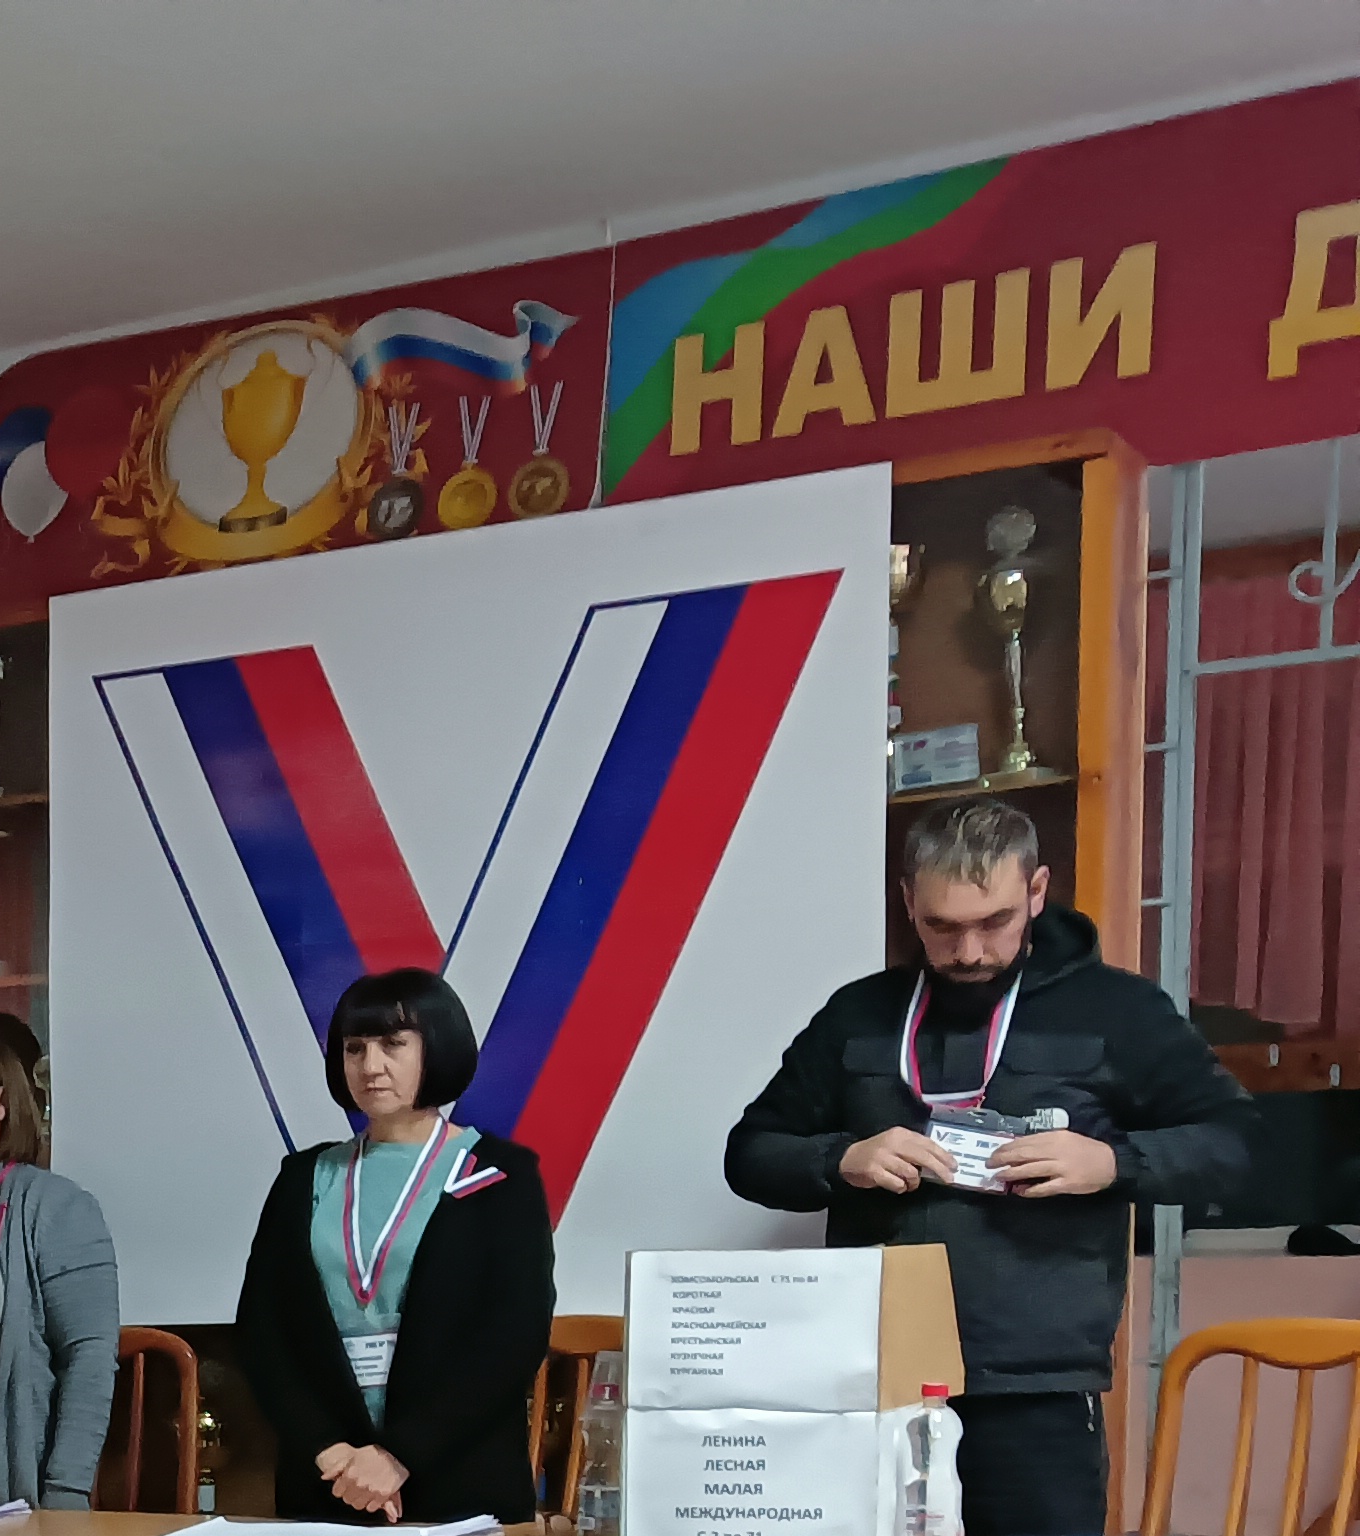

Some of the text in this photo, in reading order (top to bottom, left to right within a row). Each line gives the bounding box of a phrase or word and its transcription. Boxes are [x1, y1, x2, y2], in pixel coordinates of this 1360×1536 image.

[669, 241, 1159, 456] НАШИ
[701, 1435, 766, 1447] ЛЕНИНА
[703, 1459, 766, 1472] ЛЕСНАЯ
[704, 1483, 763, 1495] МАЛАЯ
[675, 1506, 823, 1521] МЕЖДУНАРОДНАЯ
